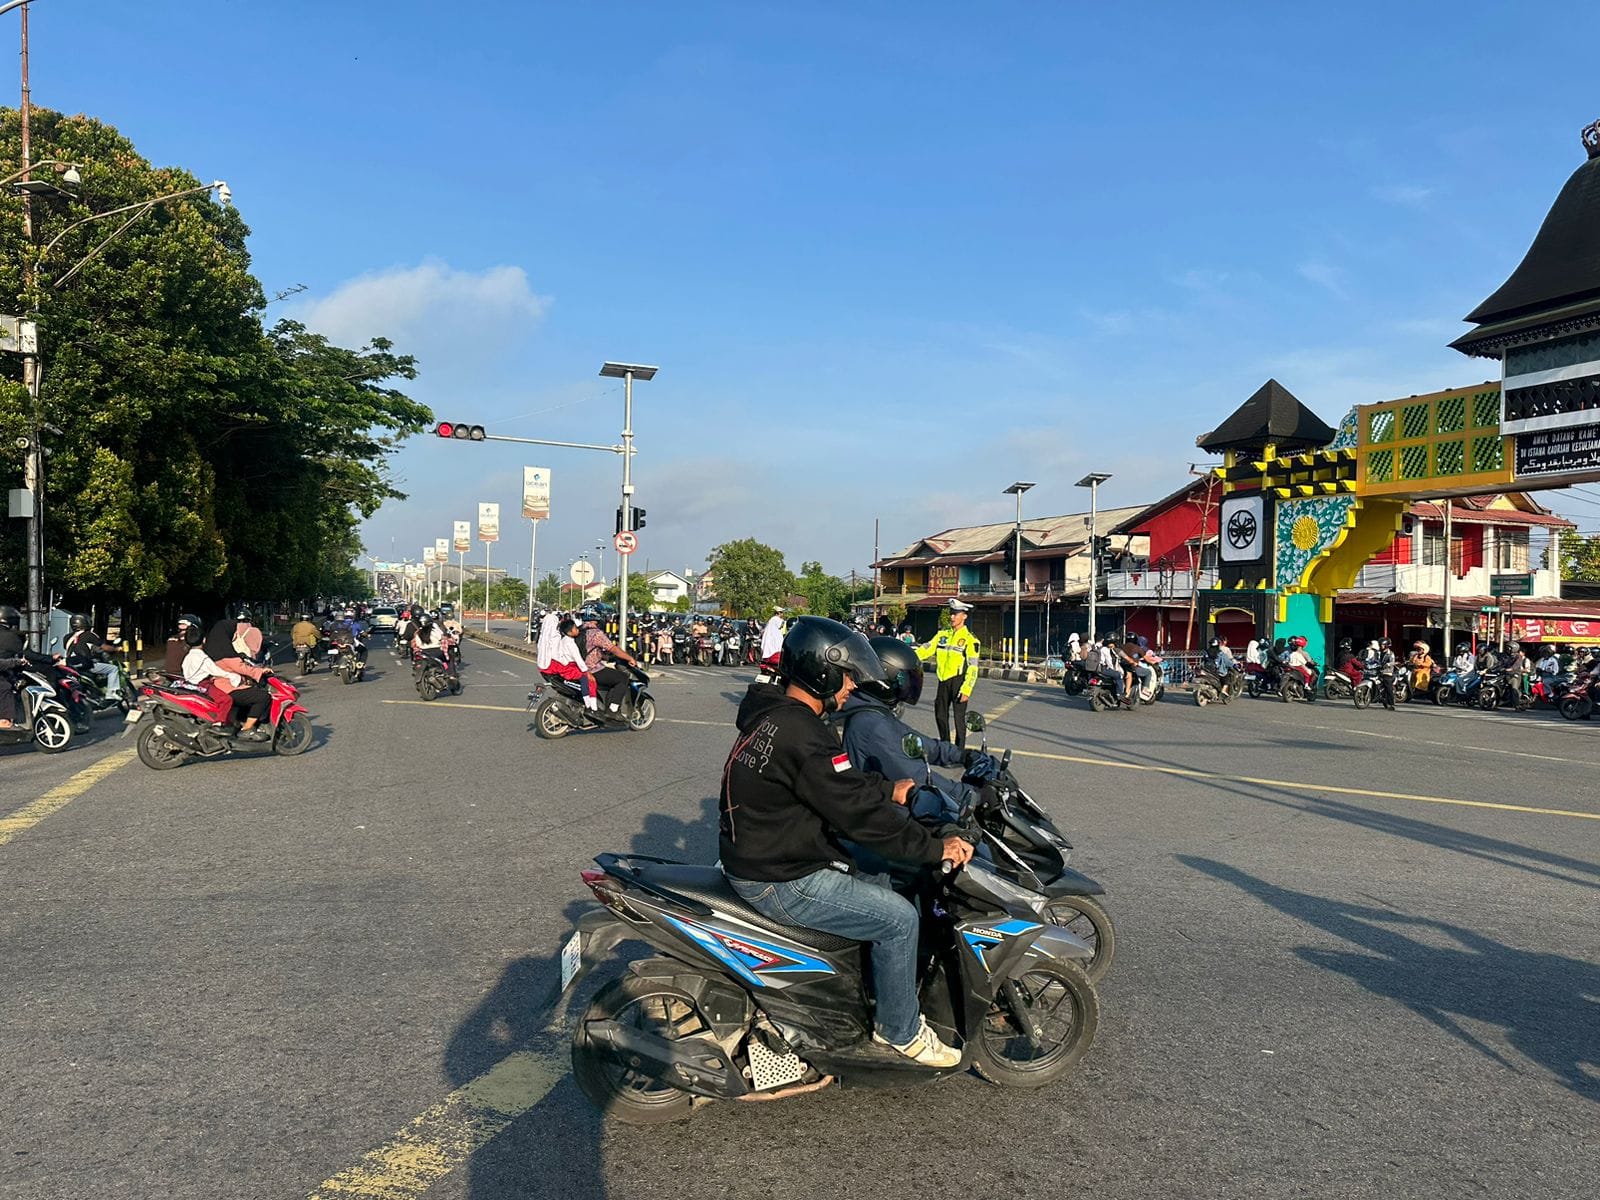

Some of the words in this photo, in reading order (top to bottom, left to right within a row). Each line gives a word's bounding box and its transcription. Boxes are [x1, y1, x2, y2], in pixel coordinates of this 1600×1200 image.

[1552, 432, 1575, 443] DATANG
[1528, 446, 1546, 458] ISTANA
[758, 755, 769, 774] ?
[973, 927, 1002, 938] HONDA
